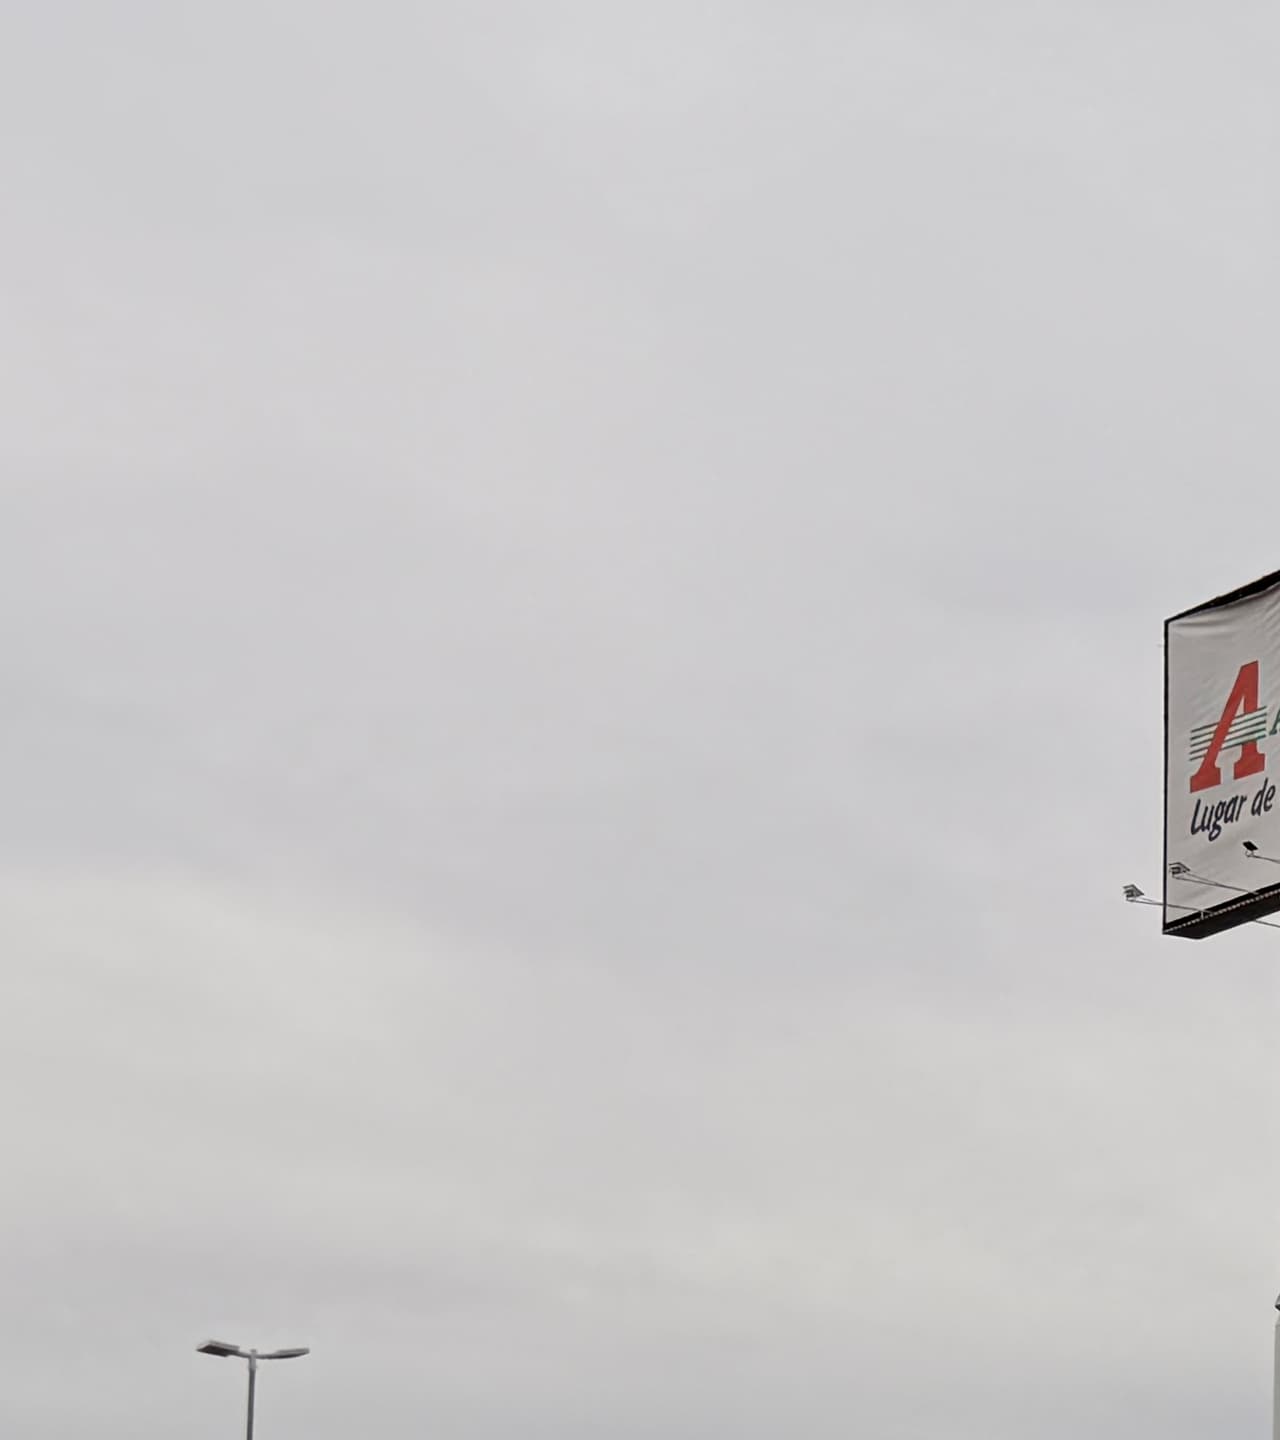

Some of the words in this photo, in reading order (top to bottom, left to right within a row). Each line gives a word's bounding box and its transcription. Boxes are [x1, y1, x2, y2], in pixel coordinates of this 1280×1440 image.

[1190, 660, 1265, 793] A
[1190, 795, 1248, 842] Lugar
[1251, 777, 1275, 817] de
